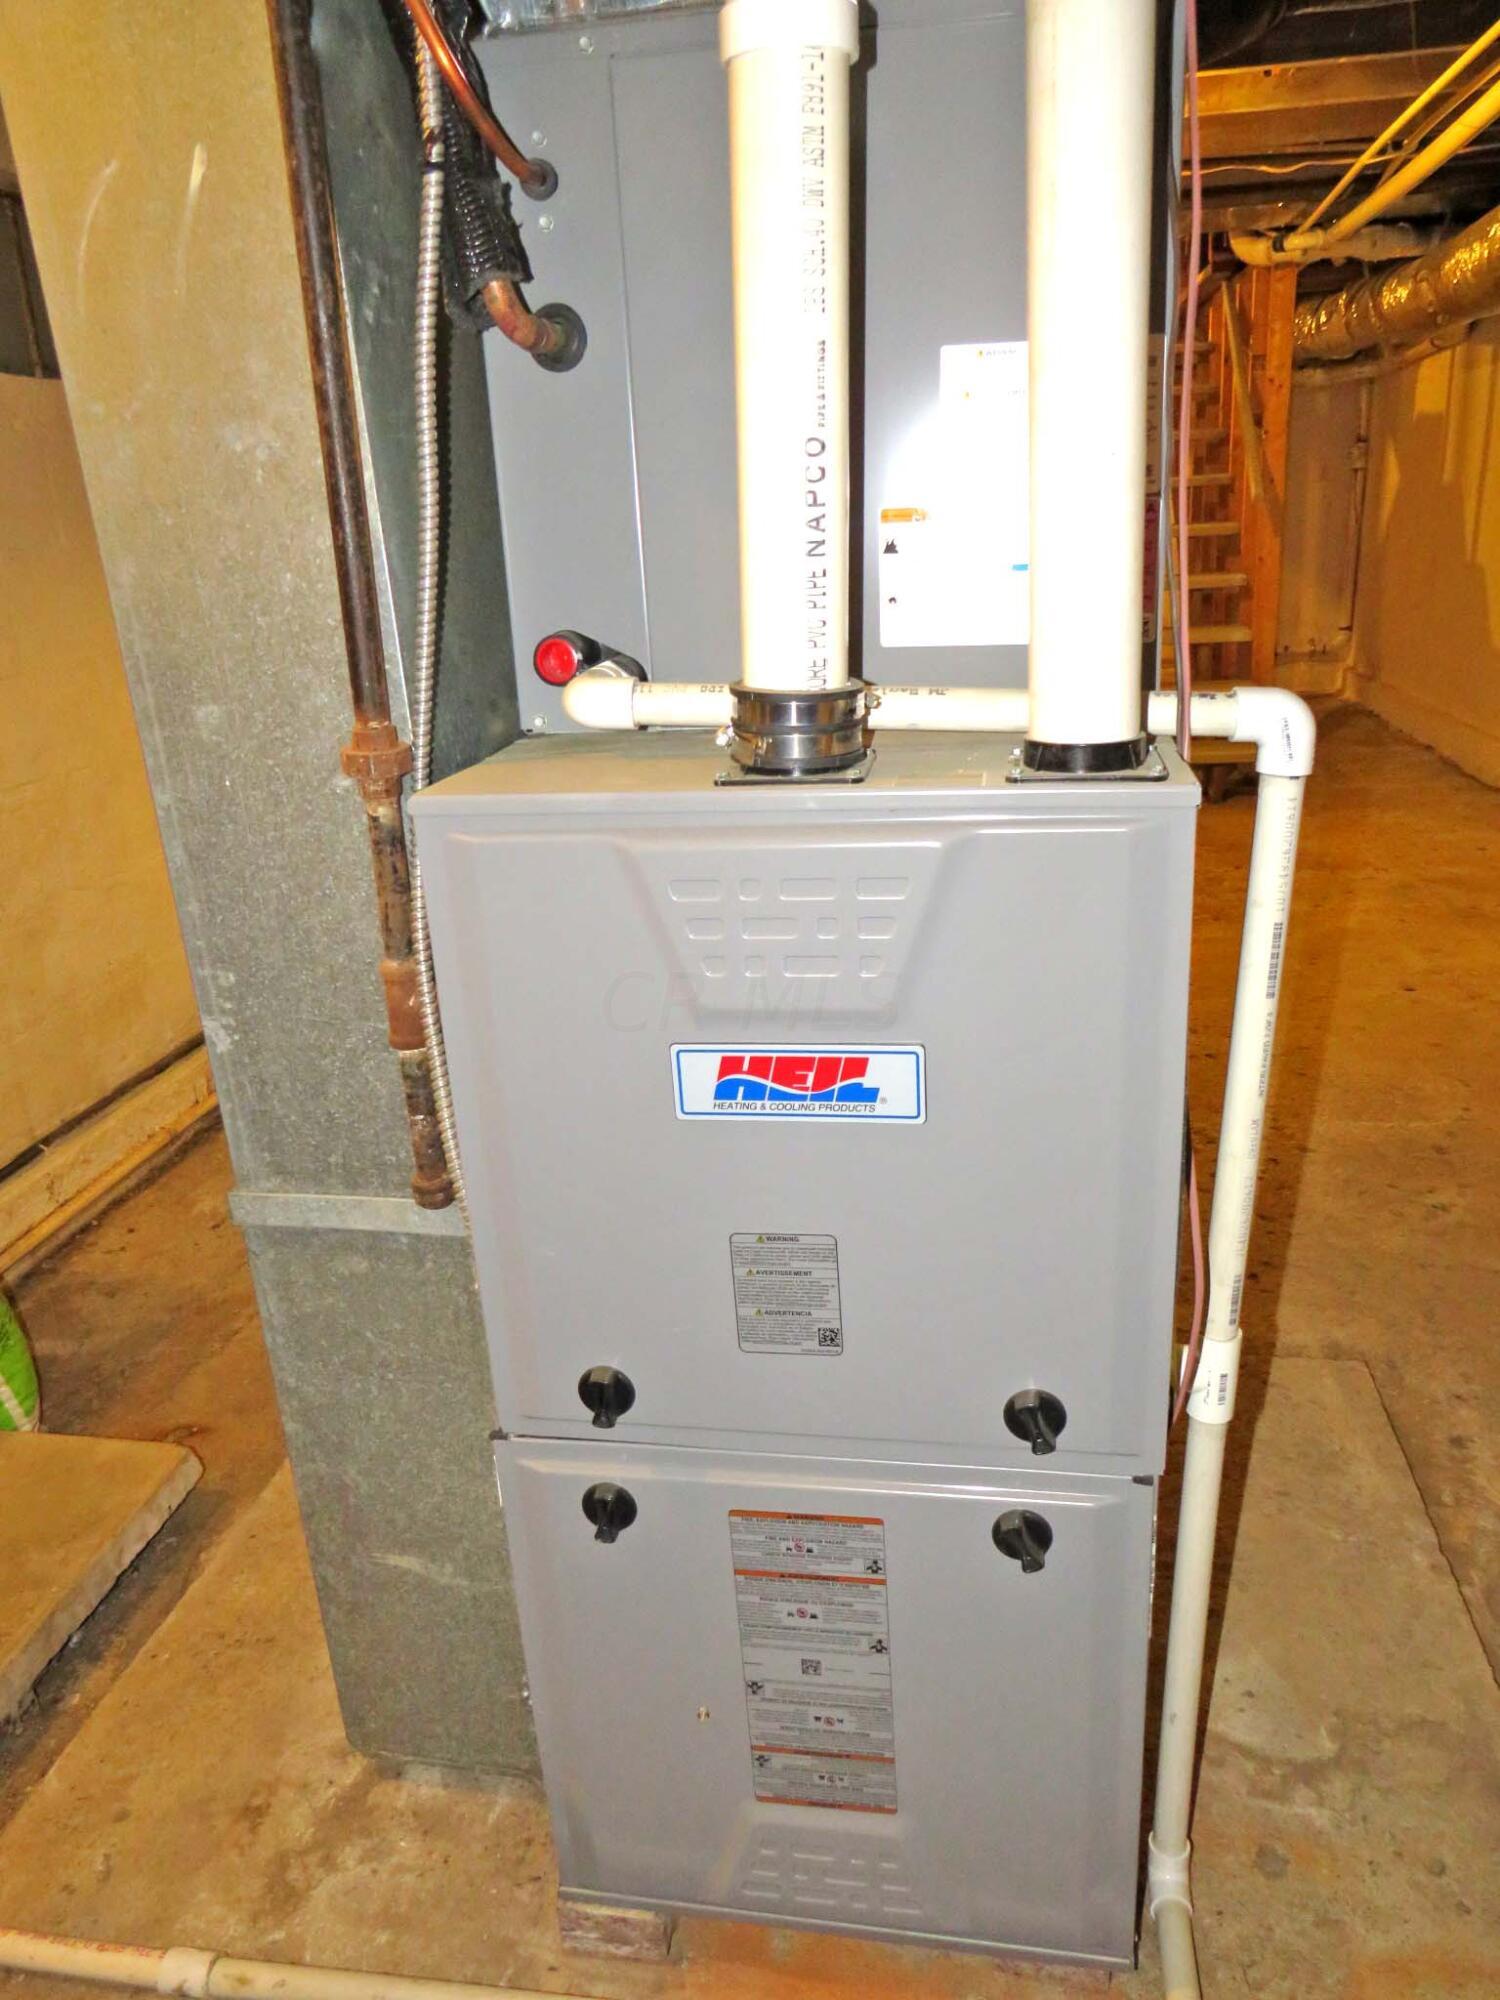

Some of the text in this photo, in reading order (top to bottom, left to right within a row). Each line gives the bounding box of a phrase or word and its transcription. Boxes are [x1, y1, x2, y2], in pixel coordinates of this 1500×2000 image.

[801, 124, 826, 168] ASTM
[802, 175, 826, 208] DWV
[804, 437, 827, 558] NAPCO
[806, 568, 828, 610] PIPE
[806, 658, 828, 692] ORE
[712, 1055, 881, 1105] HEIL
[712, 1101, 876, 1114] HEATING & COOLING PRODUCTS
[755, 1269, 813, 1277] AVERTISSEMENT
[764, 1309, 813, 1317] ADVERTENCIA
